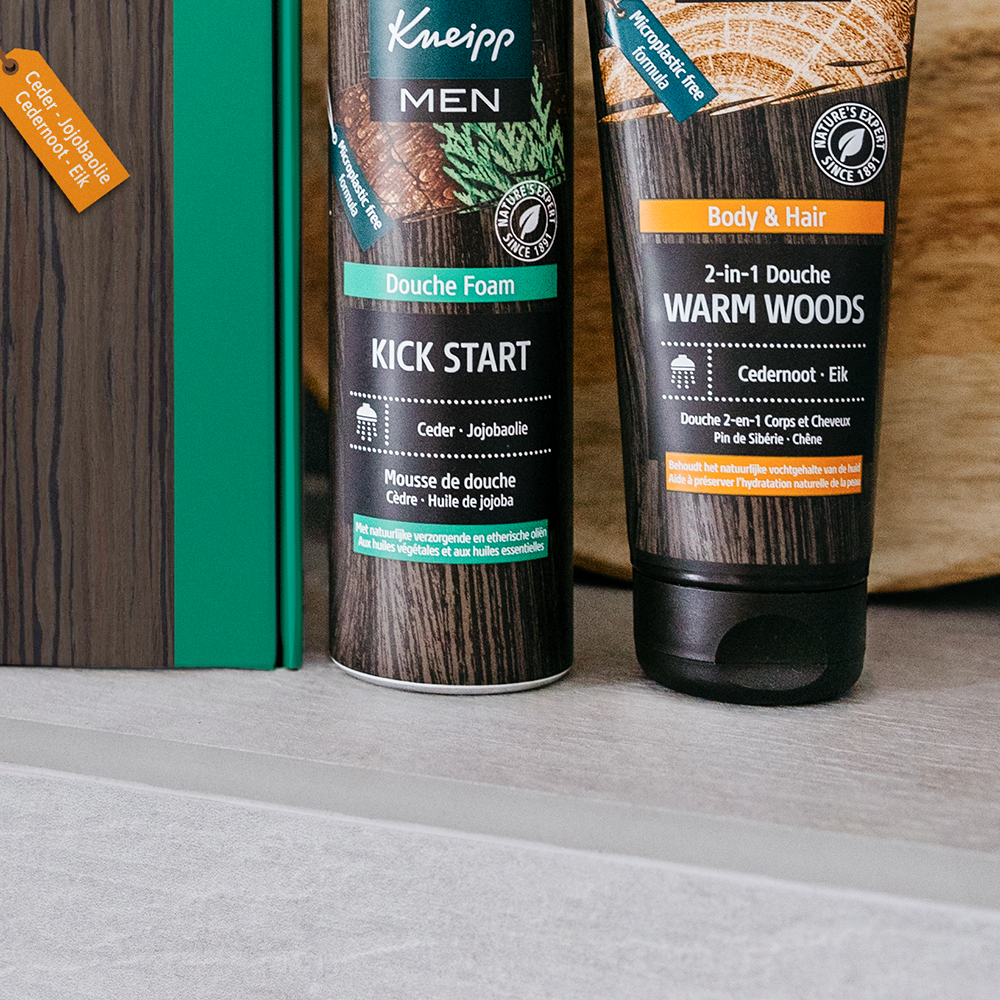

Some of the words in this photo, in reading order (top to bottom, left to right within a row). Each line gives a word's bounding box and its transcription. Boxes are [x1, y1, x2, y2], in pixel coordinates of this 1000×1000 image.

[387, 6, 515, 62] Kneipp
[629, 9, 686, 79] Microplastic
[681, 74, 705, 101] free
[632, 45, 669, 91] formula
[400, 88, 500, 113] MEN
[15, 91, 70, 160] Cedernoot
[68, 163, 91, 188] Eik
[25, 71, 57, 111] Ceder
[58, 117, 111, 185] Jojobaolie
[814, 106, 857, 149] NATURE'S
[859, 108, 885, 150] EXPERT
[821, 156, 854, 182] SINCE
[857, 156, 880, 180] 1891
[338, 139, 370, 208] Microplastic
[365, 204, 383, 231] free
[338, 173, 359, 218] formula
[497, 183, 535, 227] NATURE'S
[536, 185, 556, 224] EXPERT
[708, 206, 758, 231] Body
[764, 206, 780, 227] &
[786, 206, 827, 228] Hair
[502, 232, 531, 258] SINCE
[534, 232, 552, 256] 1891
[386, 272, 457, 297] Douche
[464, 275, 515, 296] Foam
[704, 264, 759, 284] 2-in-1
[766, 264, 831, 284] Douche
[663, 293, 756, 324] WARM
[763, 293, 865, 325] WOODS
[371, 337, 435, 373] KICK
[443, 340, 531, 373] START
[737, 365, 816, 383] Cedernoot
[829, 365, 849, 383] Eik
[417, 421, 455, 439] Ceder
[466, 421, 529, 442] Jojobaolie
[680, 412, 721, 427] Douche
[723, 413, 761, 428] 2-en-1
[764, 414, 796, 431] Corps
[799, 416, 809, 428] et
[811, 415, 851, 428] Cheveux
[714, 432, 731, 444] Pin
[732, 432, 746, 444] de
[748, 431, 784, 445] Sibérie
[792, 432, 823, 445] Chêne
[384, 468, 437, 489] Mousse
[441, 472, 460, 489] de
[464, 472, 516, 489] douche
[668, 459, 702, 472] Behoudt
[703, 461, 719, 473] het
[720, 463, 767, 476] natuurlijke
[768, 464, 822, 477] vochtgehalte
[823, 466, 837, 474] van
[838, 464, 847, 474] de
[668, 473, 686, 485] Aide
[693, 475, 735, 488] préserver
[793, 478, 829, 489] naturelle
[830, 478, 839, 488] de
[386, 490, 418, 507] Cèdre
[427, 491, 459, 508] Huile
[462, 493, 477, 508] de
[479, 492, 514, 511] jojoba
[355, 521, 369, 535] Met
[369, 526, 412, 543] natuurlijke
[413, 531, 471, 546] verzorgende
[473, 534, 485, 543] en
[486, 530, 530, 543] etherische
[357, 535, 371, 549] Aux
[372, 538, 396, 553] huiles
[396, 542, 440, 557] végétales
[441, 546, 452, 557] et
[453, 547, 471, 557] aux
[472, 545, 500, 557] huiles
[501, 541, 545, 556] essentielles
